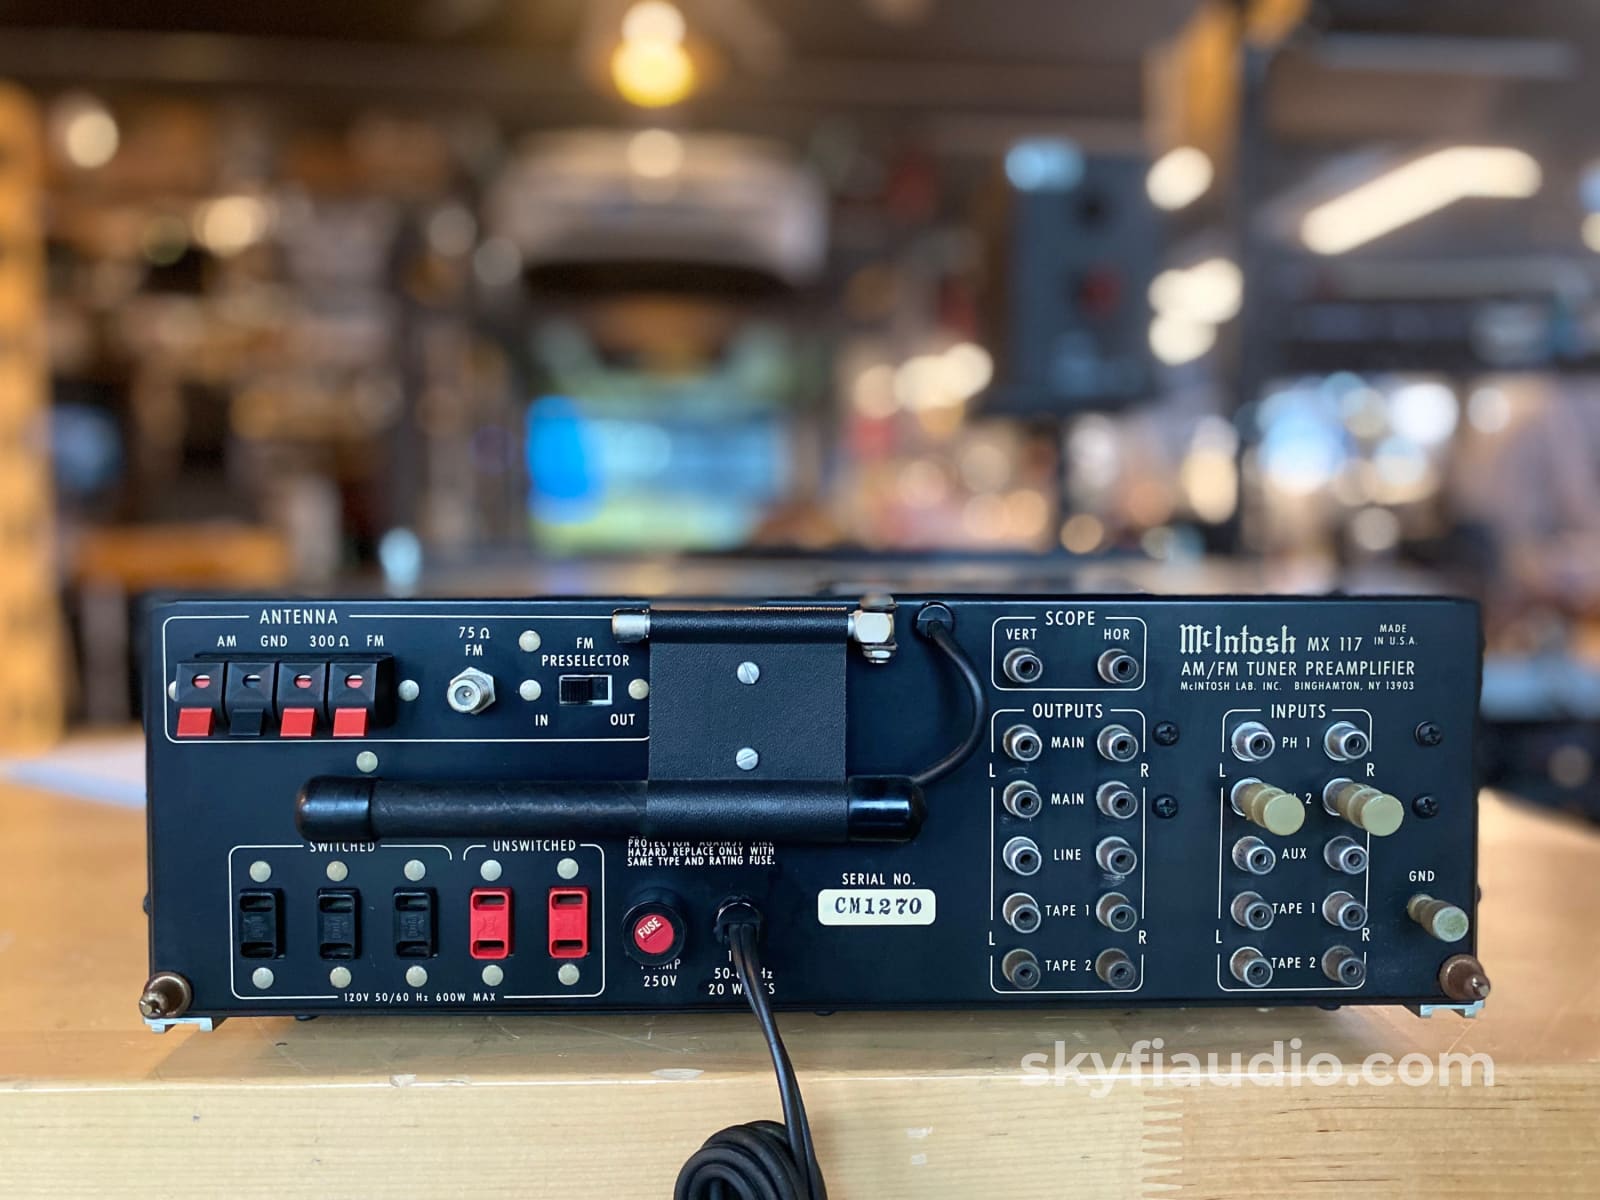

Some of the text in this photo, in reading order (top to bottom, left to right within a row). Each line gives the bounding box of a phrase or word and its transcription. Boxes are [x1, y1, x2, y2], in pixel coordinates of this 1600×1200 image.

[260, 609, 337, 624] ANTENNA
[1046, 611, 1095, 625] SCOPE
[459, 626, 474, 638] 75
[1006, 628, 1037, 640] VERT
[1104, 628, 1129, 640] HOR
[1380, 624, 1406, 633] MADE
[217, 635, 236, 647] AM
[261, 635, 287, 647] GND
[310, 635, 334, 647] 300
[367, 635, 384, 646] FM
[577, 637, 593, 649] FM
[1180, 624, 1296, 654] McIntosh
[1308, 637, 1362, 651] MX 117
[1374, 636, 1417, 645] IN U.S.A.
[466, 644, 482, 656] FM
[542, 655, 629, 666] PRESELECTOR
[1182, 661, 1414, 679] AM/FM TUNER PREAMPLIFIER
[1181, 681, 1414, 690] McINTOSH LAB. INC. BINGHAMTON, NY 13903
[1033, 703, 1102, 718] OUTPUTS
[1271, 704, 1325, 718] INPUTS
[536, 714, 548, 726] IN
[610, 714, 635, 725] OUT
[1051, 737, 1084, 748] MAIN
[1283, 737, 1311, 748] PH 1
[988, 763, 997, 777] L
[1140, 763, 1149, 777] R
[1219, 763, 1227, 777] L
[1366, 763, 1375, 776] R
[1051, 793, 1084, 804] MAIN
[1305, 793, 1312, 804] 2
[493, 840, 575, 852] UNSWITCHED
[628, 846, 774, 857] HAZARD REPLACE ONLY WITH
[1054, 849, 1080, 860] LINE
[1282, 848, 1306, 859] AUX
[628, 855, 775, 866] SAME TYPE AND RATING FUSE.
[842, 873, 915, 885] SERIAL NO.
[1409, 871, 1434, 881] GND
[834, 896, 922, 915] CM1270
[1045, 905, 1090, 916] TAPE 1
[1272, 903, 1315, 915] TAPE 1
[637, 917, 662, 939] FUSE
[988, 931, 996, 945] L
[1138, 930, 1147, 944] R
[1215, 929, 1223, 943] L
[1361, 928, 1371, 941] R
[1046, 960, 1092, 971] TAPE 2
[1271, 957, 1316, 969] TAPE 2
[644, 975, 676, 987] 250V
[709, 984, 724, 995] 20
[345, 993, 495, 1003] 120V 50/60 Hz 600W MAX
